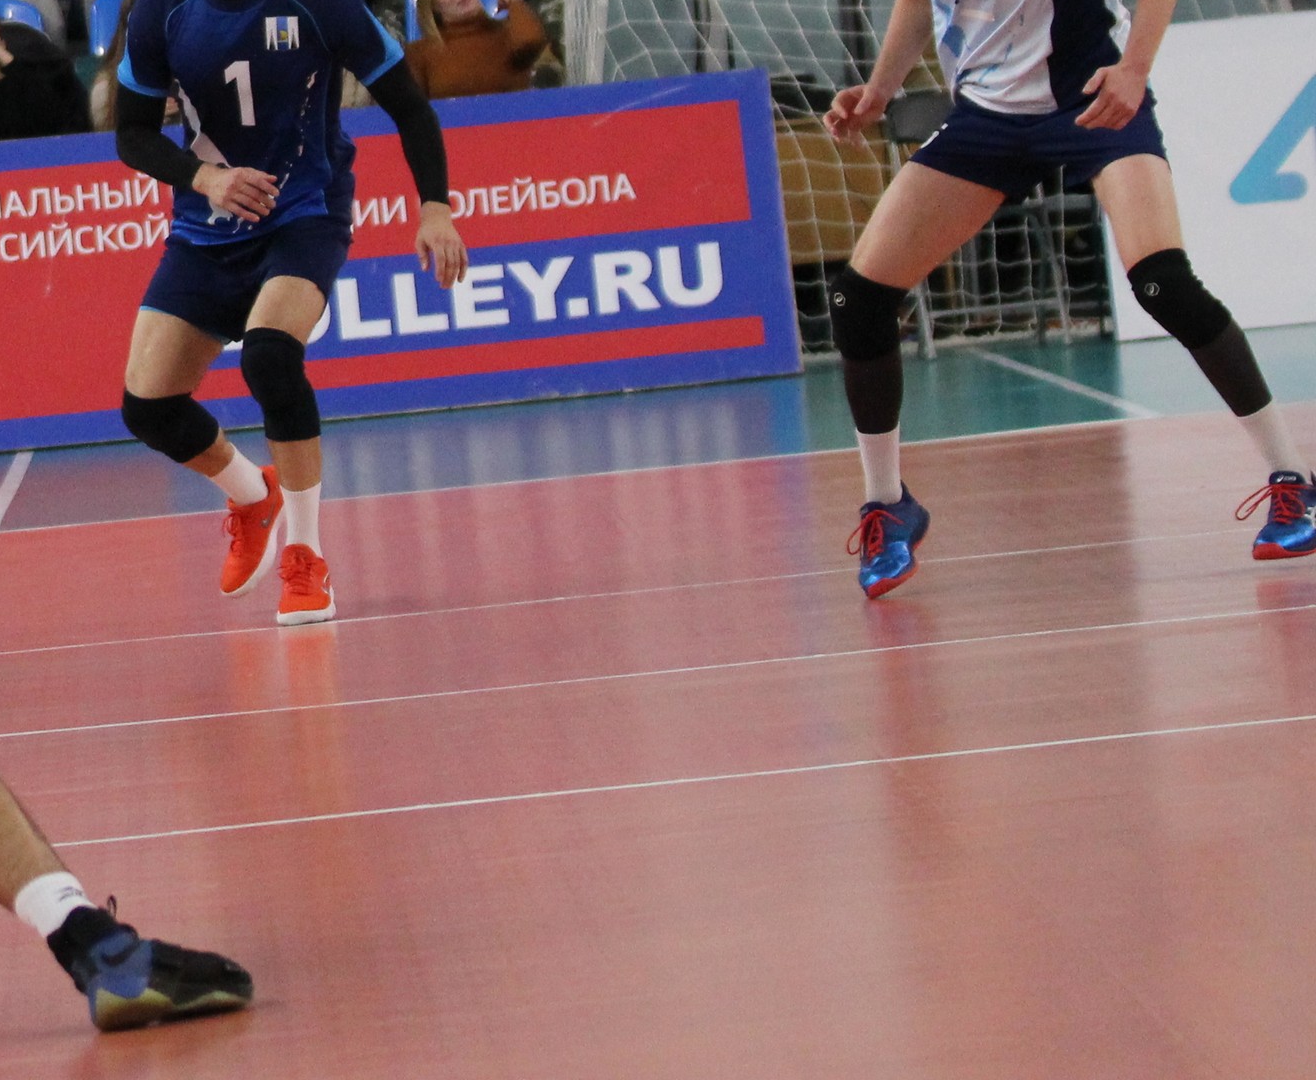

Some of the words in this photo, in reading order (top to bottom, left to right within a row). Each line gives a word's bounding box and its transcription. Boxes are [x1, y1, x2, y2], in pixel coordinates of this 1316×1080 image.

[224, 60, 256, 126] 1
[419, 172, 637, 220] ОЛЕЙБОЛА
[223, 241, 724, 352] LLEY.RU
